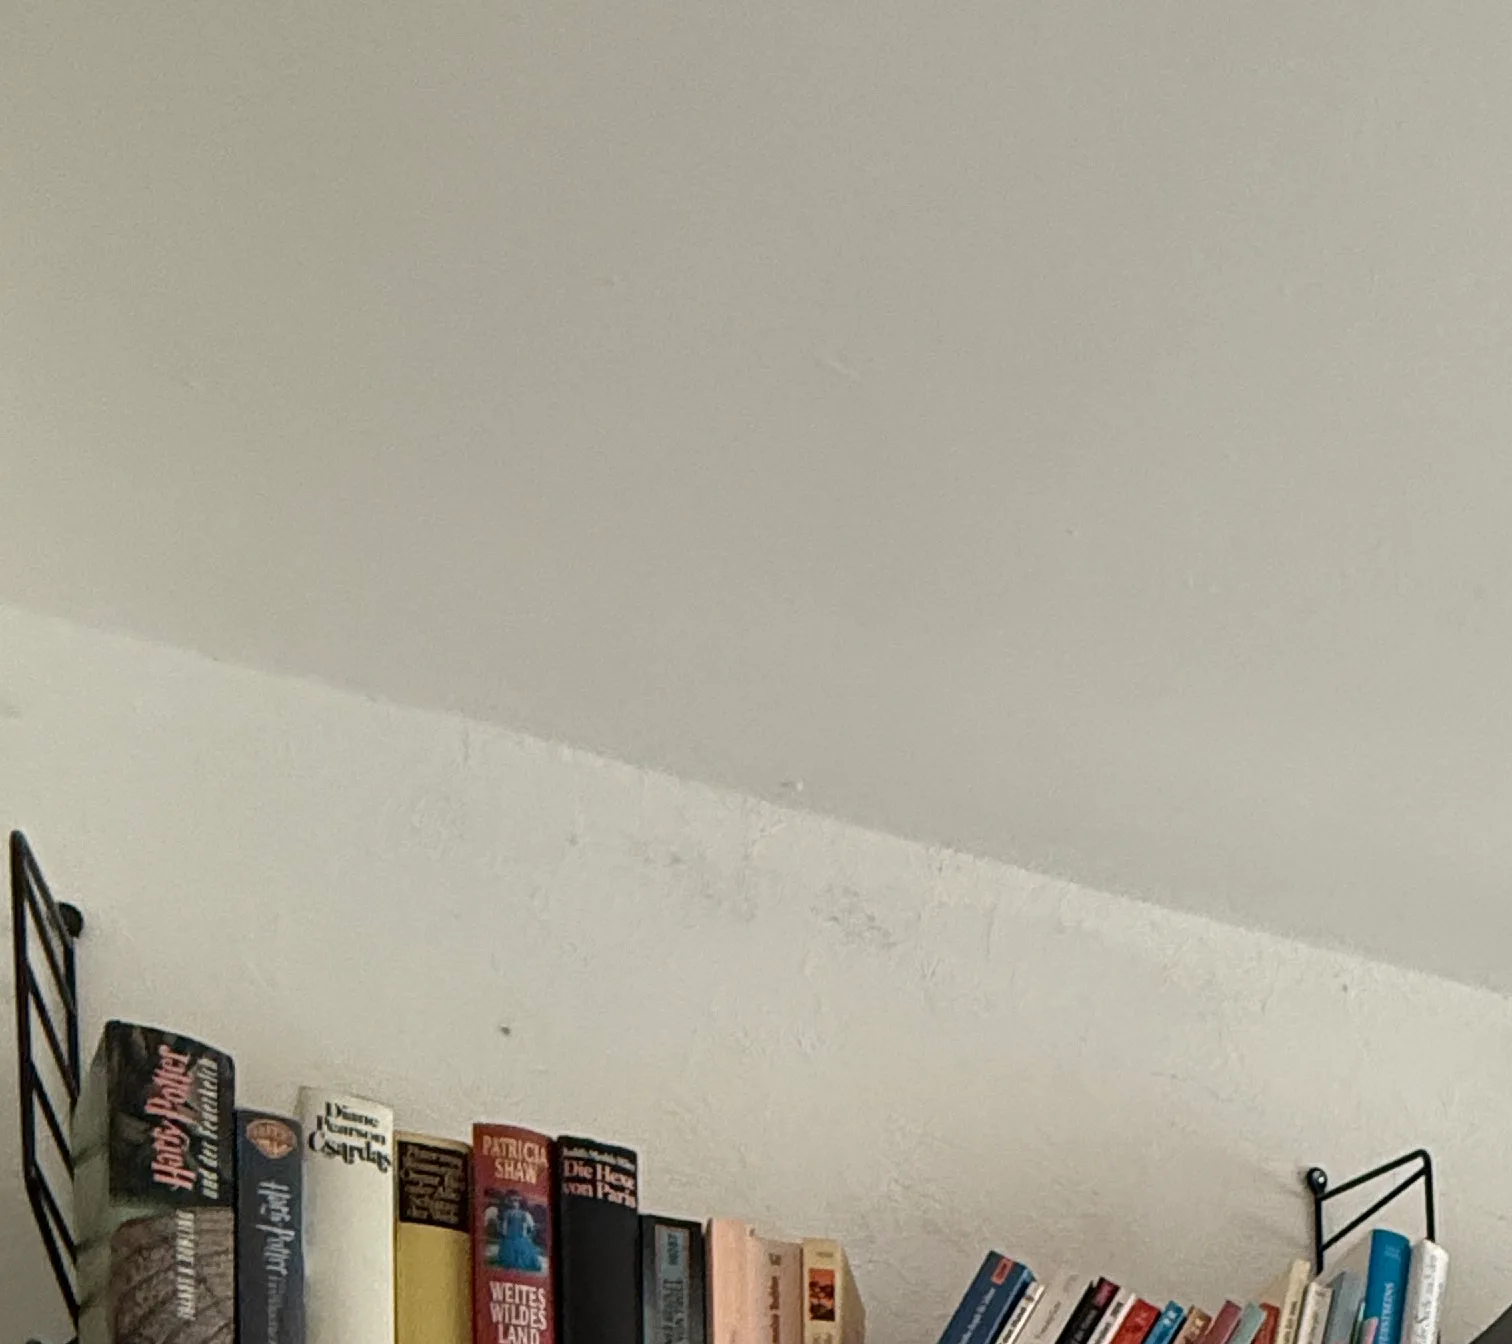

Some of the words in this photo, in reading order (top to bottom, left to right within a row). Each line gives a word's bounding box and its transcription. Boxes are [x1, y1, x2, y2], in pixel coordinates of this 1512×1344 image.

[147, 1044, 203, 1123] Potter
[150, 1119, 197, 1191] Harry
[482, 1135, 548, 1169] PATRICIA
[495, 1158, 537, 1185] SHAW
[564, 1158, 594, 1180] Die
[490, 1281, 546, 1308] WEITES
[490, 1301, 547, 1330] WILDES
